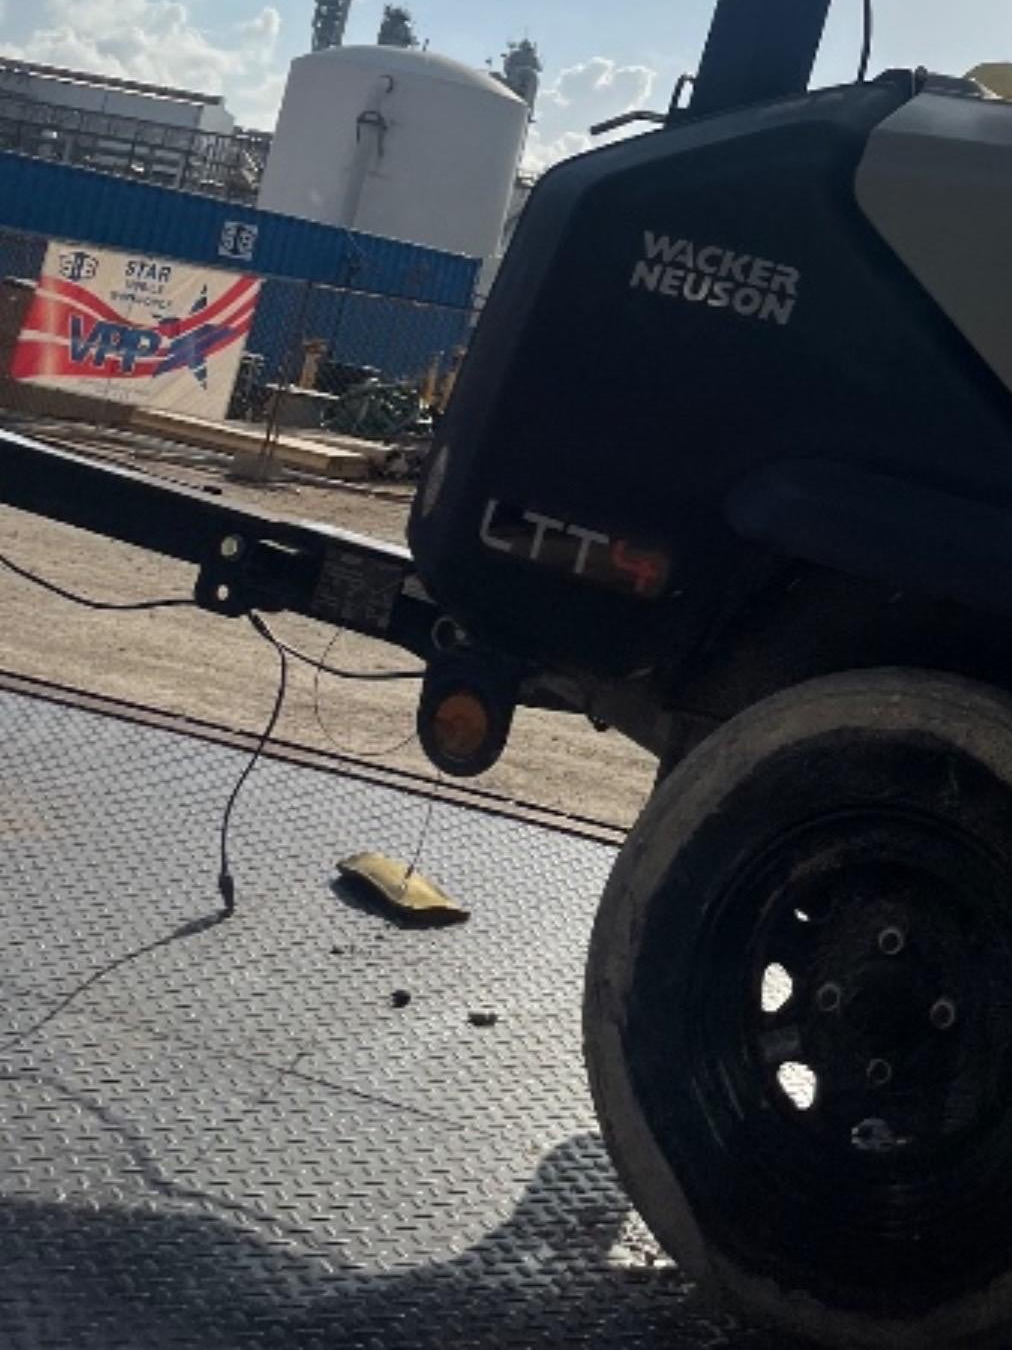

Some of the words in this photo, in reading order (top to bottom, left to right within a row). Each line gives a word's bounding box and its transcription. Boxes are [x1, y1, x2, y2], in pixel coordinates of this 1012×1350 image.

[125, 260, 172, 283] STAR
[629, 260, 796, 326] NEUSON
[643, 229, 801, 296] WACKER
[68, 313, 162, 375] VPP
